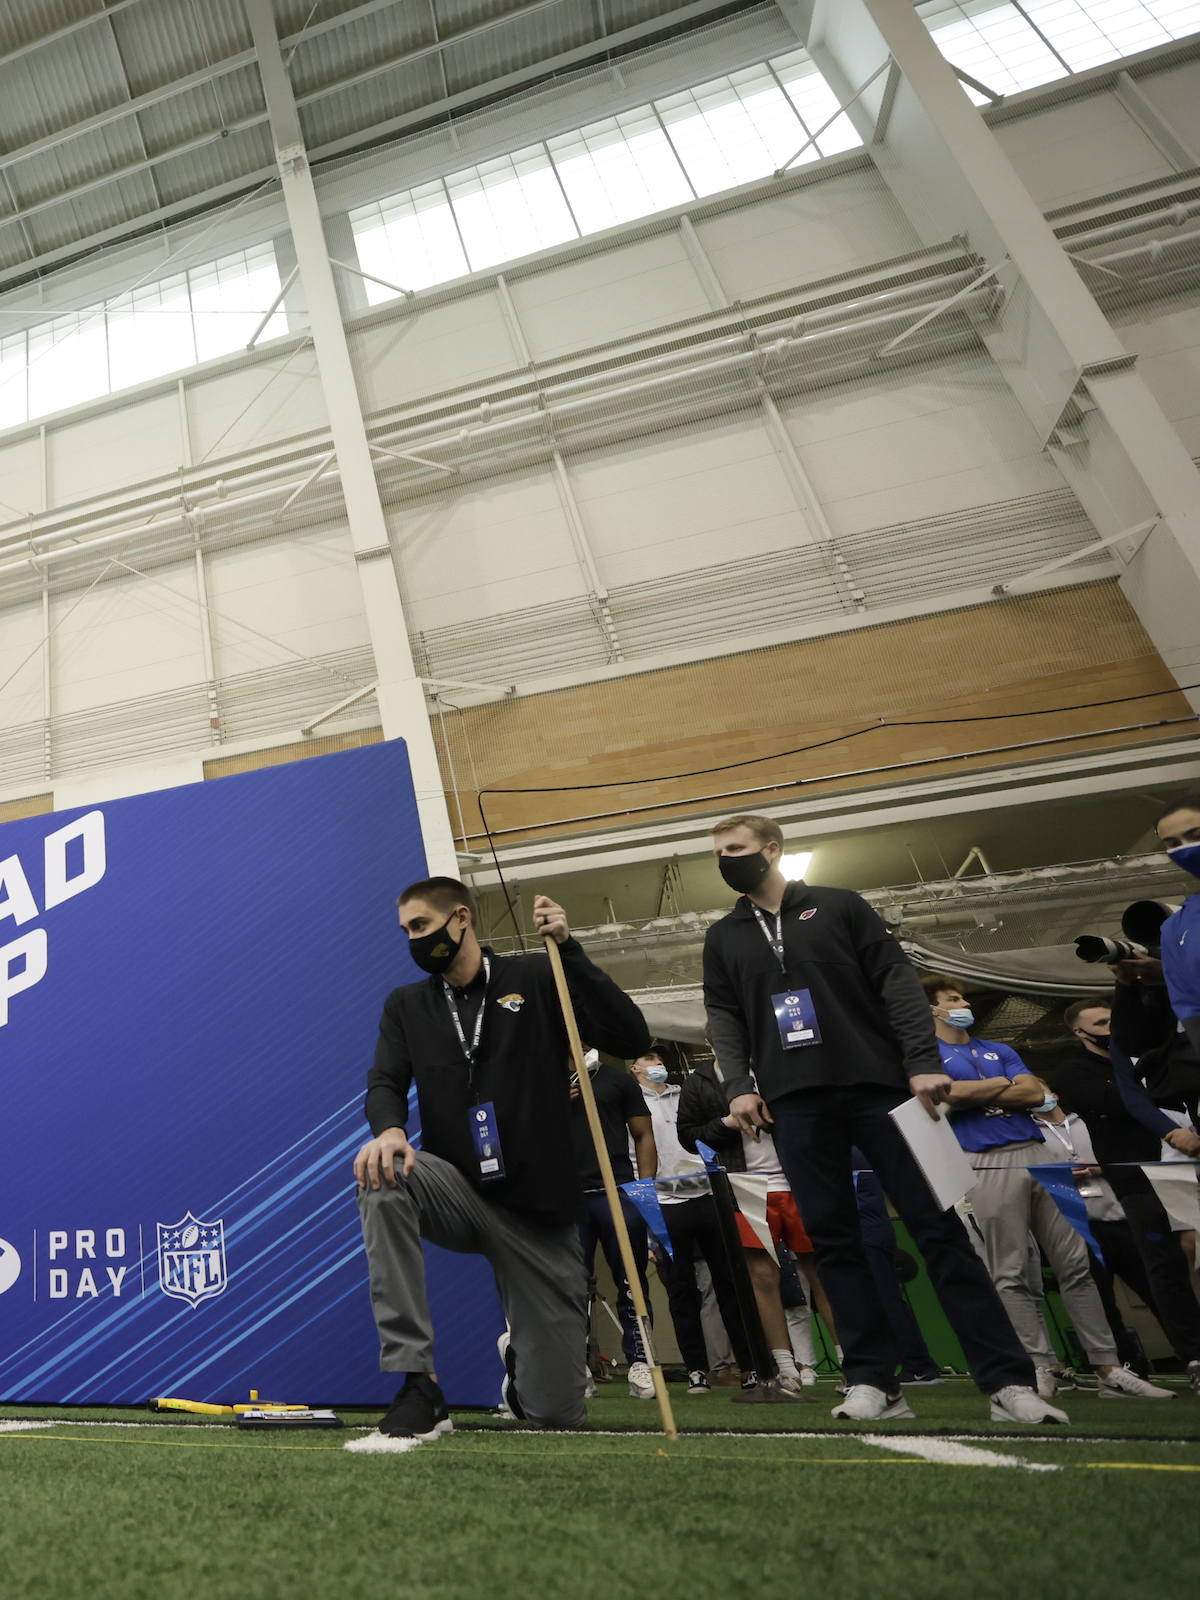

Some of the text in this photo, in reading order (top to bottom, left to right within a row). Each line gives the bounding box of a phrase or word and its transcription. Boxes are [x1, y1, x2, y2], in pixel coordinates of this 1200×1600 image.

[49, 1228, 126, 1260] PRO
[49, 1266, 127, 1299] DAY
[166, 1250, 221, 1297] NFL
